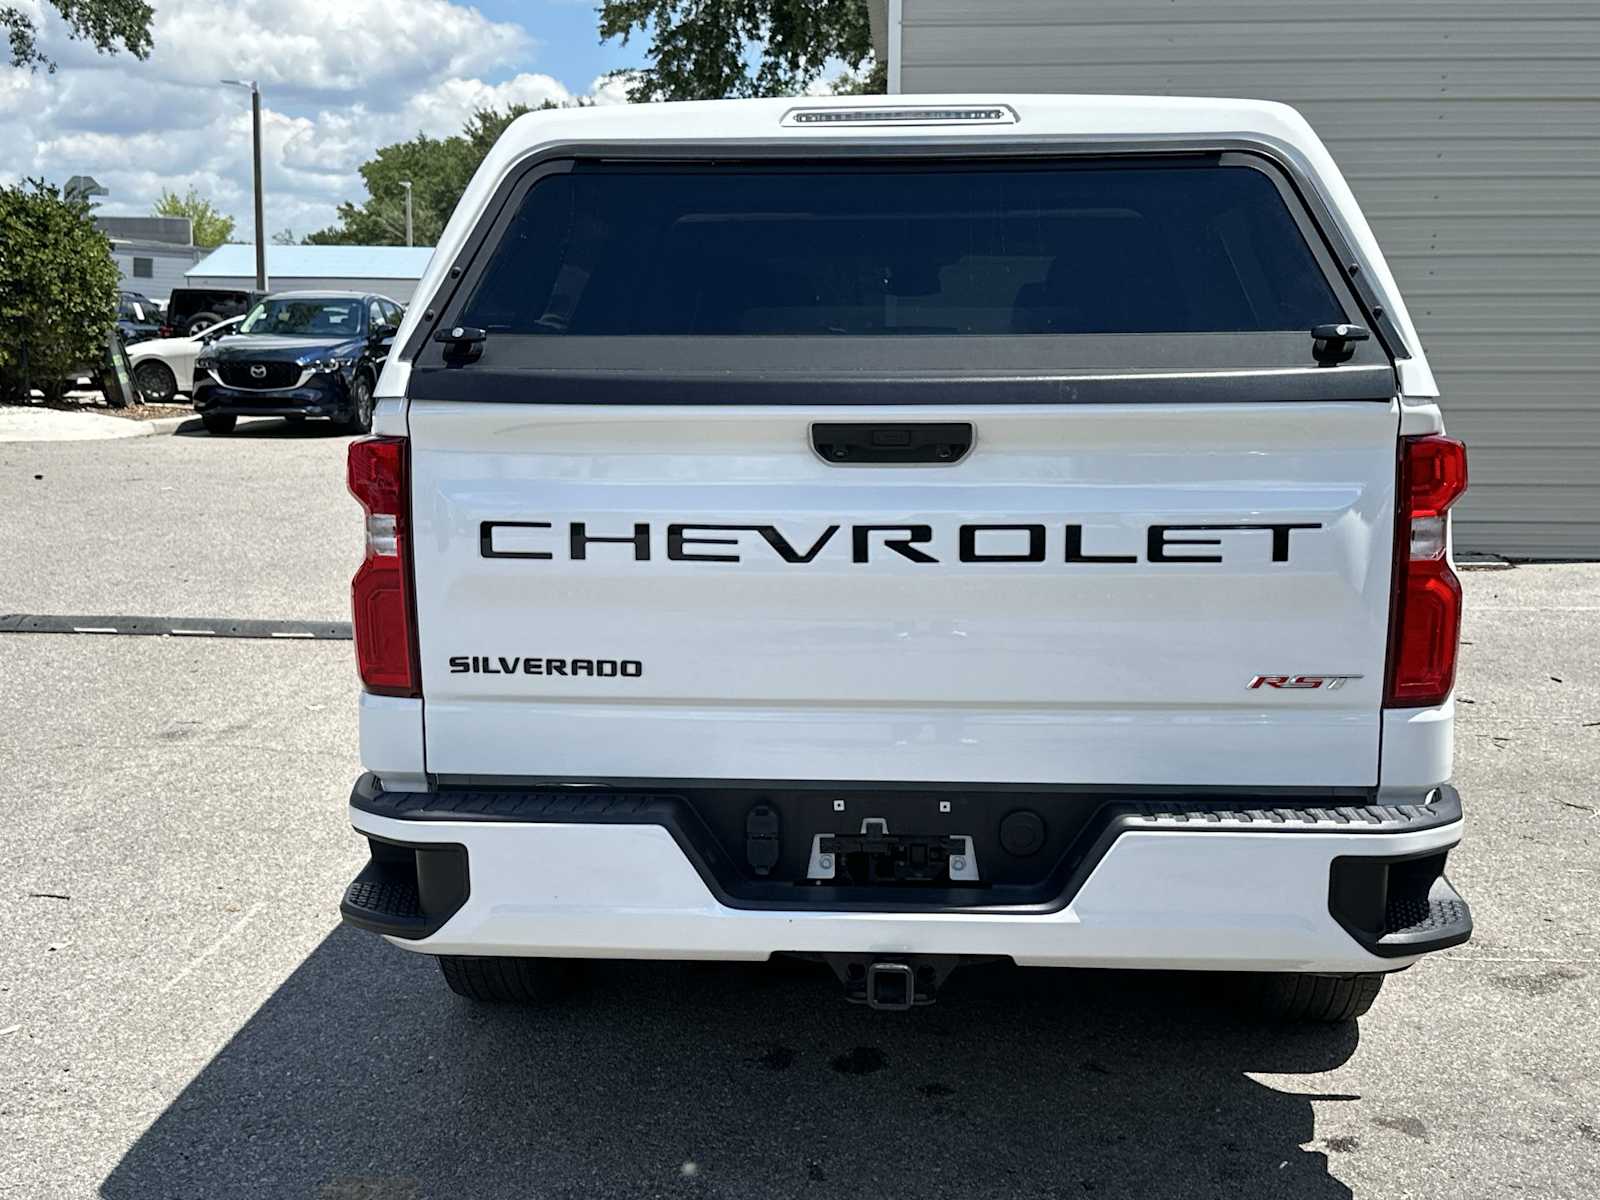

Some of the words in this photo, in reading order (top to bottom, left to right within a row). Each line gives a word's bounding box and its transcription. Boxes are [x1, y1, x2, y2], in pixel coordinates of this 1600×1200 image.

[480, 521, 1322, 563] CHEVROLET
[449, 656, 642, 678] SILVERADO
[1246, 674, 1364, 690] RST
